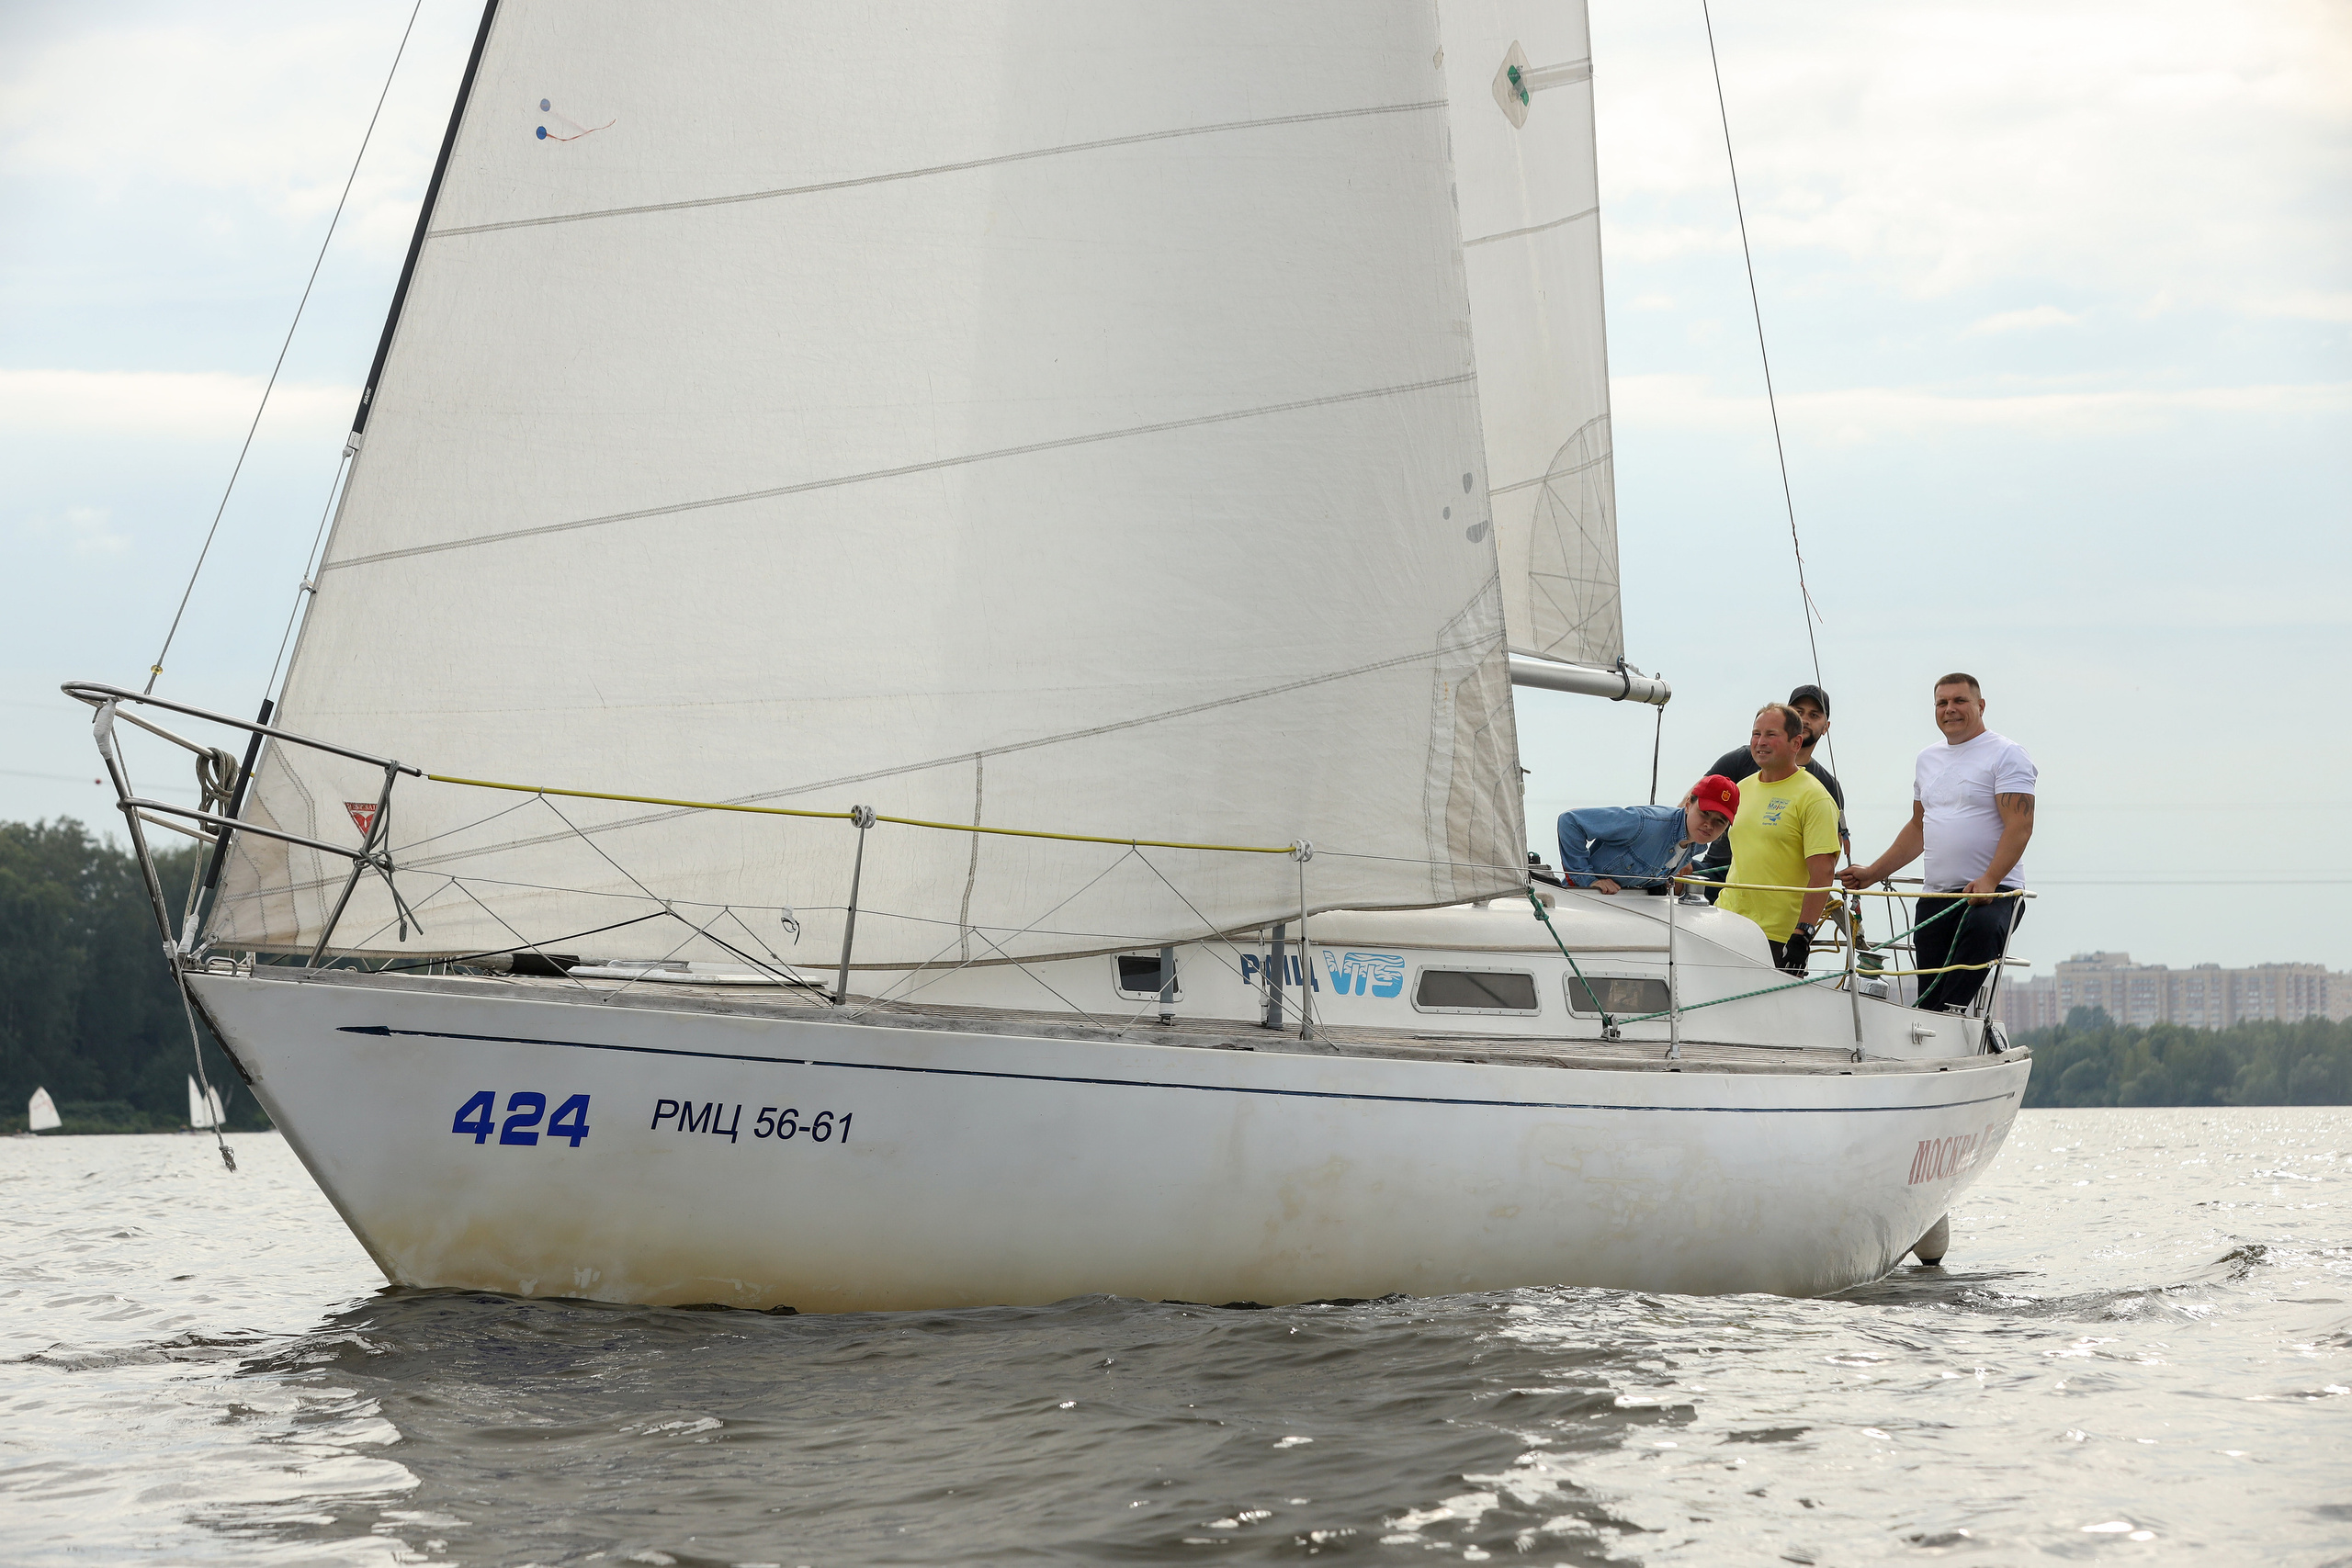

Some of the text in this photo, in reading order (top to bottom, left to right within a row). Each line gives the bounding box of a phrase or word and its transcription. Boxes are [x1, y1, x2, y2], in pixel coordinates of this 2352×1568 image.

[451, 1090, 592, 1147] 424
[650, 1099, 854, 1144] РМЦ 56-61
